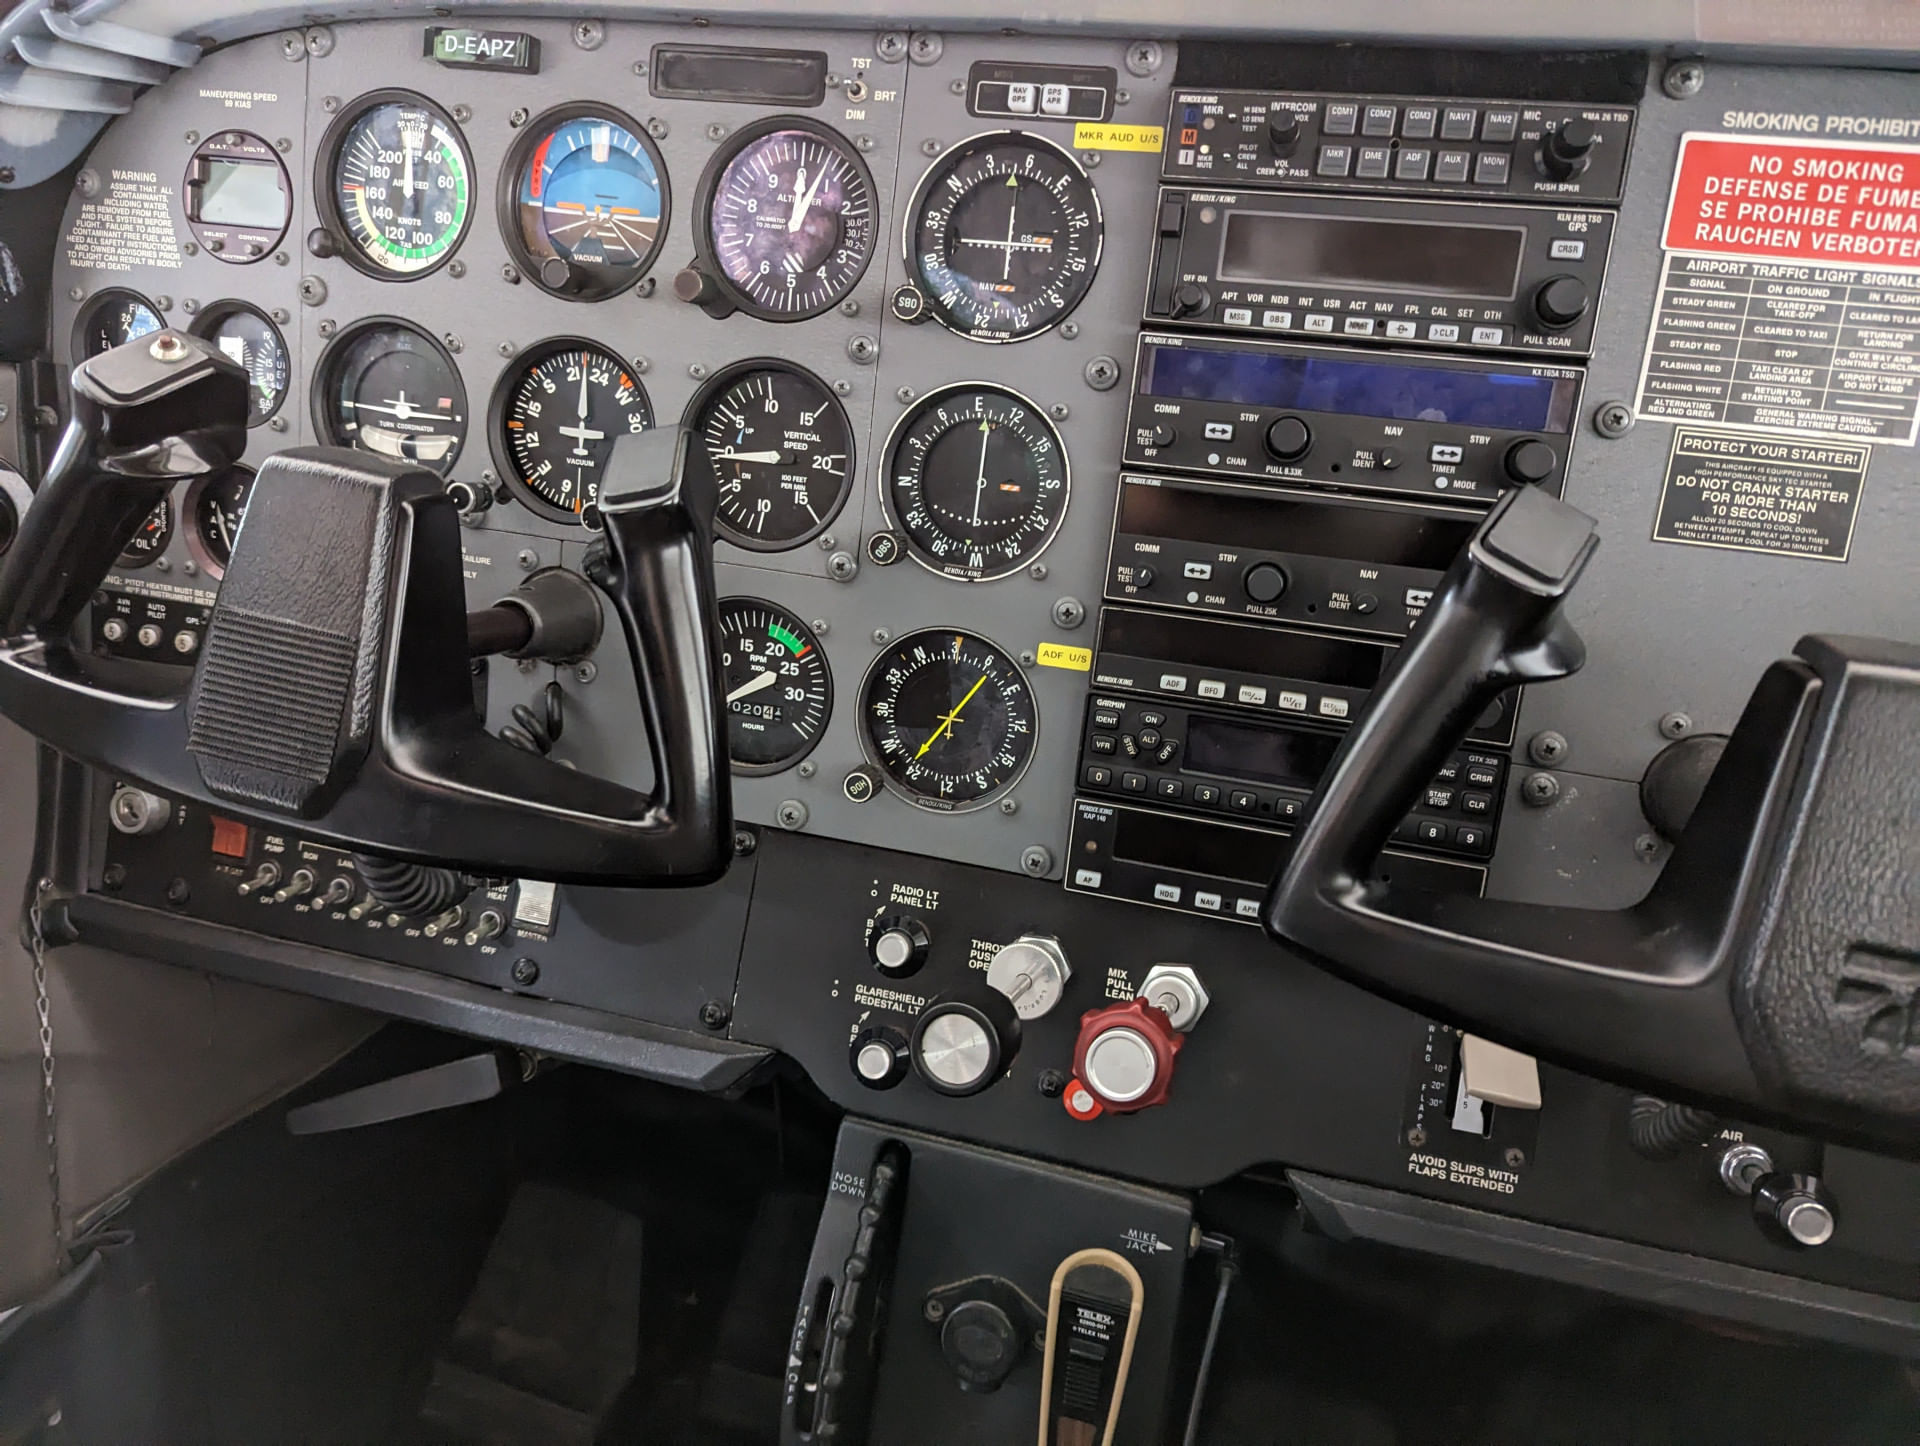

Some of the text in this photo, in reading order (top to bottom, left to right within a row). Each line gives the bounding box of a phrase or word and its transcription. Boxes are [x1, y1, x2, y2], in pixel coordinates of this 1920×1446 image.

[445, 35, 516, 58] D-EAPZ
[852, 59, 872, 68] TST
[200, 90, 278, 102] MANEUVERING SPEED
[874, 92, 896, 101] BRT
[235, 101, 252, 109] KIAS
[1203, 106, 1224, 115] MKR
[1271, 102, 1317, 113] INTERCOM
[846, 110, 865, 120] DIM
[1490, 114, 1512, 124] NAV2
[1524, 111, 1542, 121] MIC
[1722, 111, 1920, 137] SMOKING PROHIBIT
[1079, 131, 1159, 143] MKR AUD U/S
[378, 151, 402, 163] 200
[424, 151, 441, 163] 40
[1365, 151, 1382, 160] DME
[1444, 155, 1461, 164] AUX
[370, 166, 390, 179] 180
[1750, 155, 1904, 183] NO SMOKING
[112, 170, 157, 182] WARNING
[438, 176, 454, 188] 60
[768, 174, 778, 188] 9
[110, 183, 137, 191] ASSURE
[1704, 177, 1808, 200] DEFENSE
[1818, 185, 1848, 204] DE
[366, 187, 386, 200] 160
[104, 198, 142, 208] INCLUDING
[748, 200, 757, 213] 8
[841, 202, 851, 215] 2
[373, 208, 393, 220] 140
[435, 212, 452, 224] 80
[1700, 200, 1920, 233] SE PROHIBE FUMA
[398, 217, 422, 226] KNOTS
[1568, 223, 1588, 232] GPS
[385, 227, 405, 240] 120
[413, 232, 433, 244] 100
[1695, 223, 1802, 248] RAUCHEN
[745, 234, 754, 246] 7
[574, 254, 603, 263] VACUUM
[837, 250, 847, 263] 3
[760, 261, 770, 274] 6
[817, 266, 827, 279] 4
[1686, 260, 1747, 275] AIRPORT
[1752, 264, 1809, 280] TRAFFIC
[1815, 269, 1857, 283] LIGHT
[786, 275, 796, 287] 5
[1690, 278, 1726, 290] SIGNAL
[1768, 284, 1830, 297] ON GROUND
[1222, 292, 1340, 308] APT VOR NDB INT USR
[1884, 293, 1920, 305] FLIGHT
[1374, 303, 1474, 318] NAV FPL CAL SET
[1663, 318, 1705, 328] FLASHING
[1523, 336, 1571, 347] PULL SCAN
[1669, 340, 1721, 351] STEADY RED
[1660, 361, 1721, 372] FLASHING RED
[566, 367, 580, 381] 21
[589, 370, 609, 386] 24
[1651, 381, 1692, 392] FLASHING
[765, 400, 779, 413] 10
[1155, 404, 1180, 414] COMM
[800, 413, 814, 426] 15
[1240, 413, 1260, 422] STBY
[784, 431, 821, 442] VERTICAL
[1385, 426, 1403, 436] NAV
[784, 442, 808, 450] SPEED
[1470, 435, 1491, 445] STBY
[1356, 451, 1374, 460] PULL
[1684, 439, 1858, 465] PROTECT YOUR STARTER!
[566, 458, 594, 467] VACUUM
[812, 456, 832, 470] 20
[1227, 457, 1247, 466] CHAN
[1353, 460, 1375, 469] IDENT
[1266, 466, 1282, 475] PULL
[1432, 465, 1456, 474] TIMER
[1453, 480, 1477, 490] MODE
[1676, 475, 1849, 503] DO NOT CRANK STARTER
[795, 491, 808, 505] 15
[1702, 491, 1817, 513] FOR MORE THAN
[758, 499, 771, 512] 10
[1712, 505, 1802, 524] 10 SECONDS!
[1135, 543, 1160, 553] COMM
[1218, 553, 1237, 562] STBY
[1360, 570, 1378, 580] NAV
[1205, 596, 1225, 604] CHAN
[1329, 601, 1351, 610] IDENT
[1247, 605, 1263, 614] PULL
[740, 639, 753, 652] 15
[765, 643, 785, 656] 20
[750, 654, 767, 663] RPM
[1043, 650, 1087, 663] ADF U/S
[780, 662, 799, 675] 25
[1166, 679, 1180, 688] ADF
[785, 687, 804, 701] 30
[1097, 699, 1126, 710] GARMIN
[1096, 716, 1117, 725] IDENT
[1146, 716, 1157, 724] ON
[1096, 741, 1110, 749] VFR
[1470, 774, 1493, 783] CRSR
[893, 884, 939, 900] RADIO LT
[890, 894, 939, 910] PANEL LT
[1108, 968, 1128, 979] MIX
[1107, 978, 1134, 991] PULL
[856, 985, 925, 1006] GLARESHIELD
[1105, 988, 1134, 1001] LEAN
[855, 995, 920, 1015] PEDESTAL LT
[1721, 1130, 1744, 1142] AIR
[1409, 1153, 1518, 1183] AVOID SLIPS WITH
[835, 1172, 865, 1188] NOSE
[1408, 1164, 1514, 1193] FLAPS EXTENDED
[832, 1182, 866, 1198] DOWN
[1128, 1229, 1157, 1242] MIKE
[1126, 1240, 1155, 1254] JACK
[1077, 1308, 1111, 1324] TELEX
